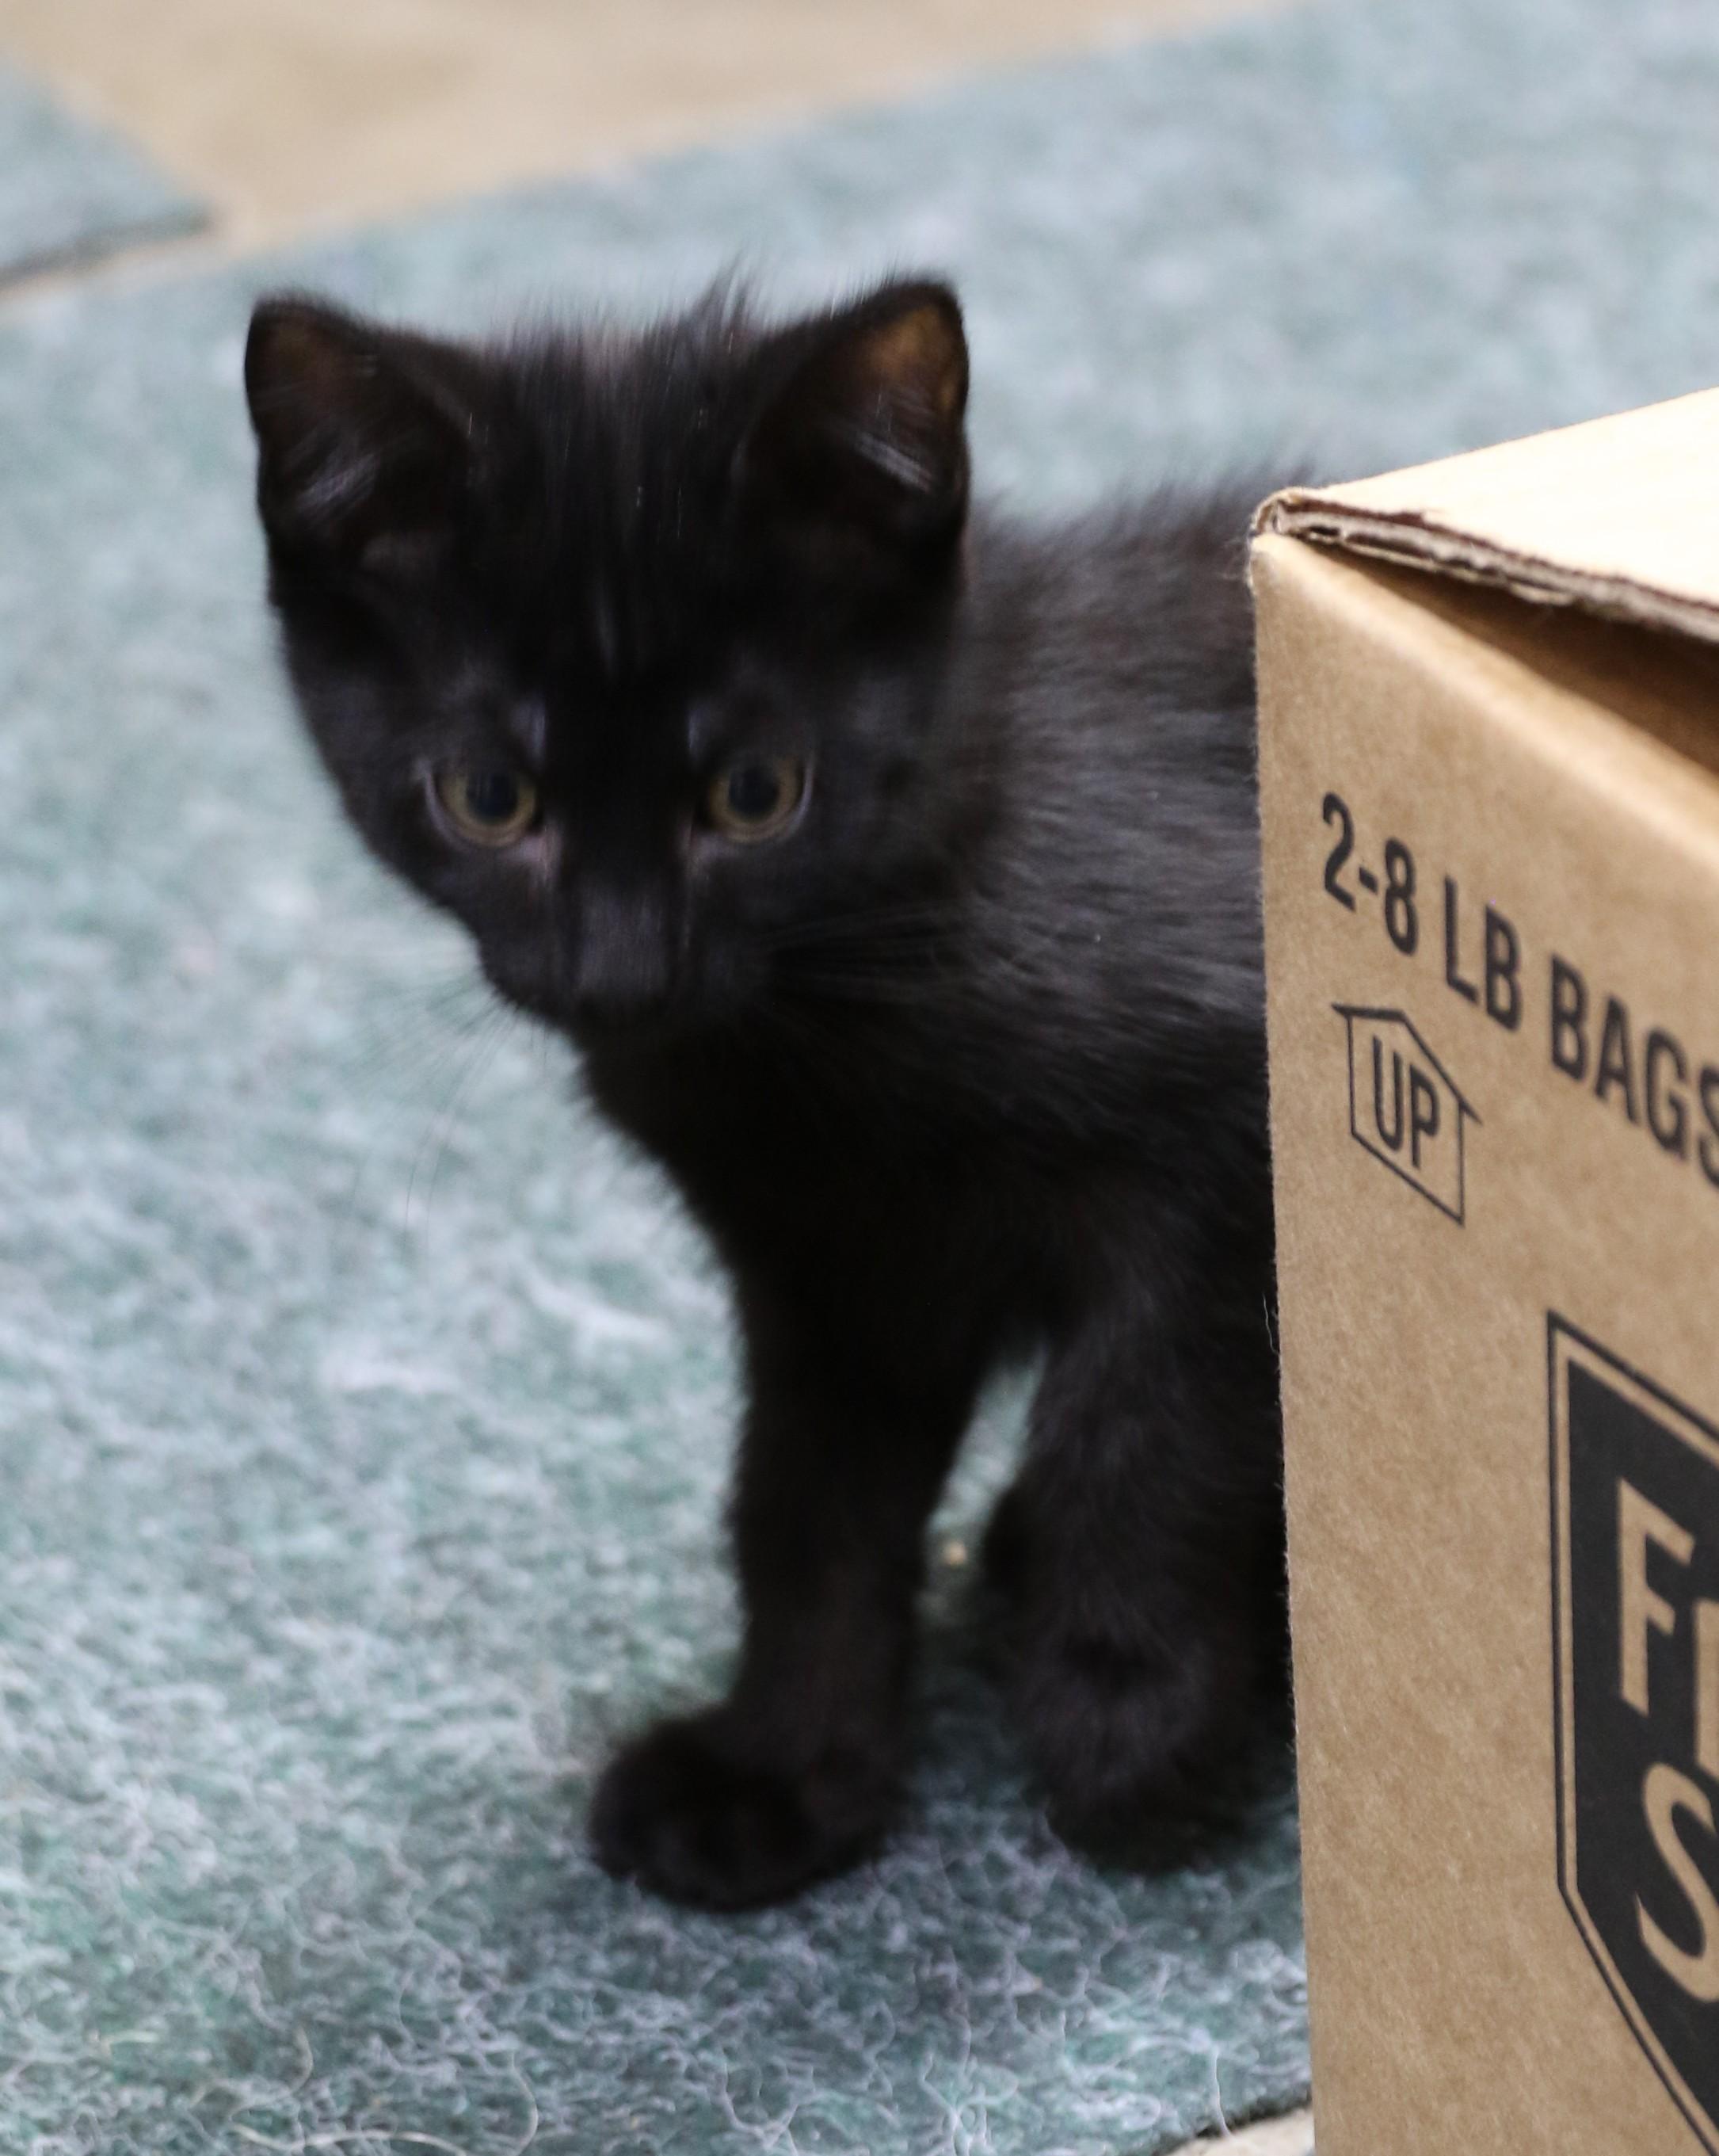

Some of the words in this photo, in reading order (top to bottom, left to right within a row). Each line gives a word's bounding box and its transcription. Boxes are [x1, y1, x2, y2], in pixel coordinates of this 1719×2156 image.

[1322, 792, 1420, 957] 2-8
[1444, 874, 1523, 1034] LB
[1372, 1033, 1440, 1170] UP
